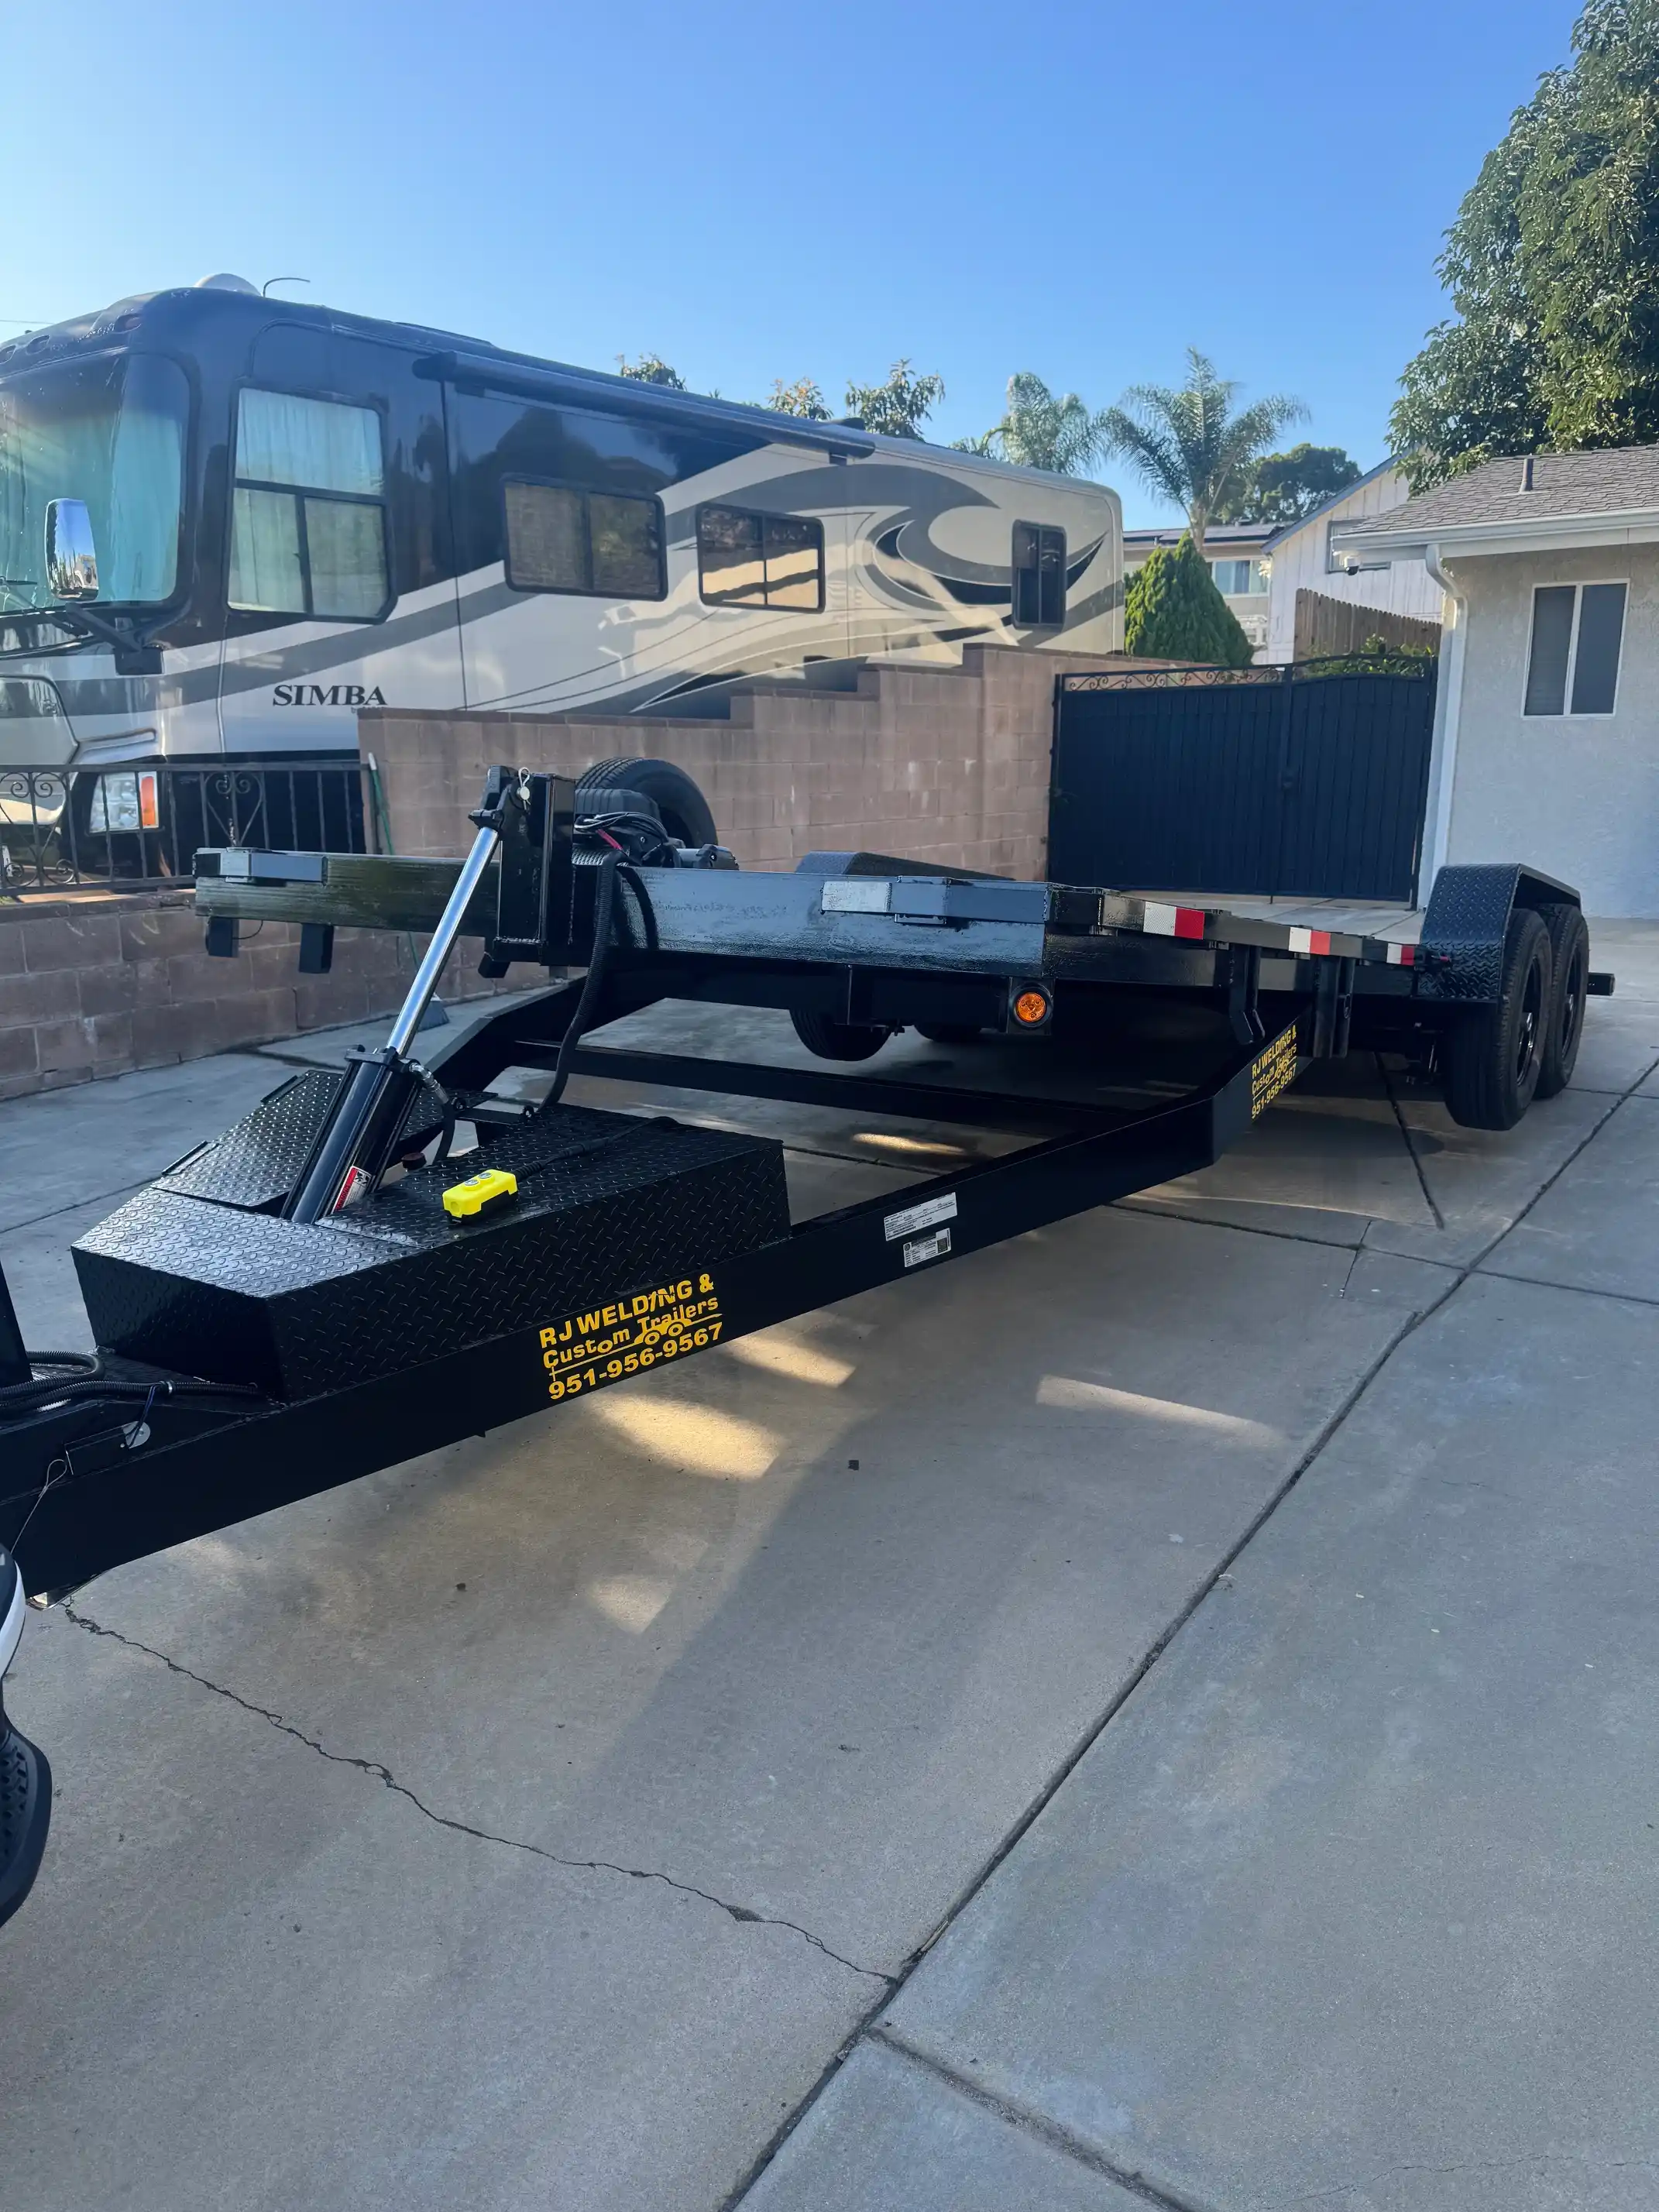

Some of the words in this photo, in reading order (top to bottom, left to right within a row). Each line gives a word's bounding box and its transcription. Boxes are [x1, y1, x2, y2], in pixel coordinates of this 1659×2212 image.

[273, 685, 387, 706] SIMBA
[1252, 1058, 1261, 1079] RJ
[1261, 1029, 1291, 1069] WELDING
[1252, 1066, 1275, 1095] Custom
[1252, 1063, 1297, 1119] 951-956-9567
[539, 1321, 572, 1348] RJ
[576, 1280, 692, 1334] WELDING
[699, 1273, 714, 1293] &
[543, 1328, 630, 1369] Custom
[637, 1297, 719, 1334] Trailers
[548, 1322, 723, 1400] 951-956-9567
